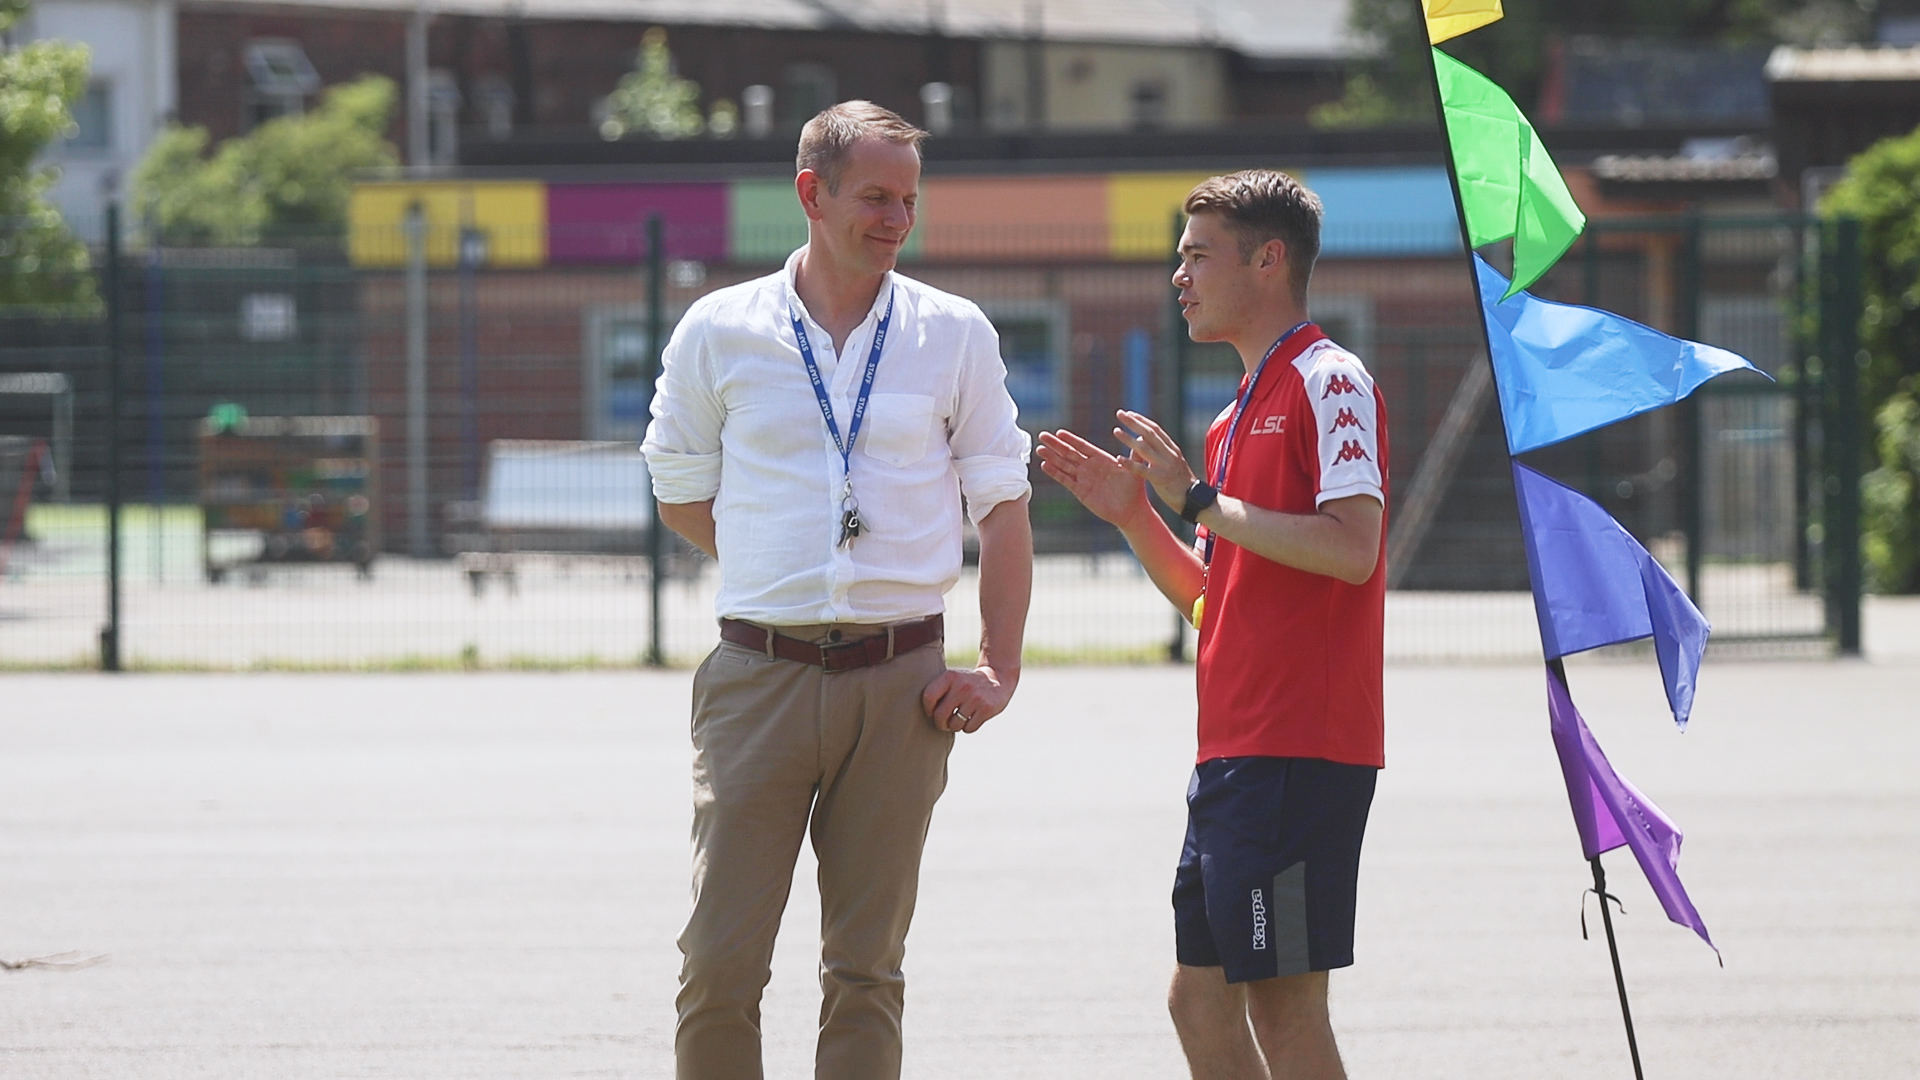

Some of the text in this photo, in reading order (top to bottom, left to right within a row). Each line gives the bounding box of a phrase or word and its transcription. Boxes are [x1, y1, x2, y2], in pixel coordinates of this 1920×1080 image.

[797, 331, 809, 352] STAFF
[874, 330, 884, 351] STAFF
[808, 364, 820, 386] STAFF
[865, 362, 875, 385] STAFF
[821, 398, 832, 421] STAFF
[855, 396, 866, 418] STAFF
[1252, 888, 1266, 950] Kappa
